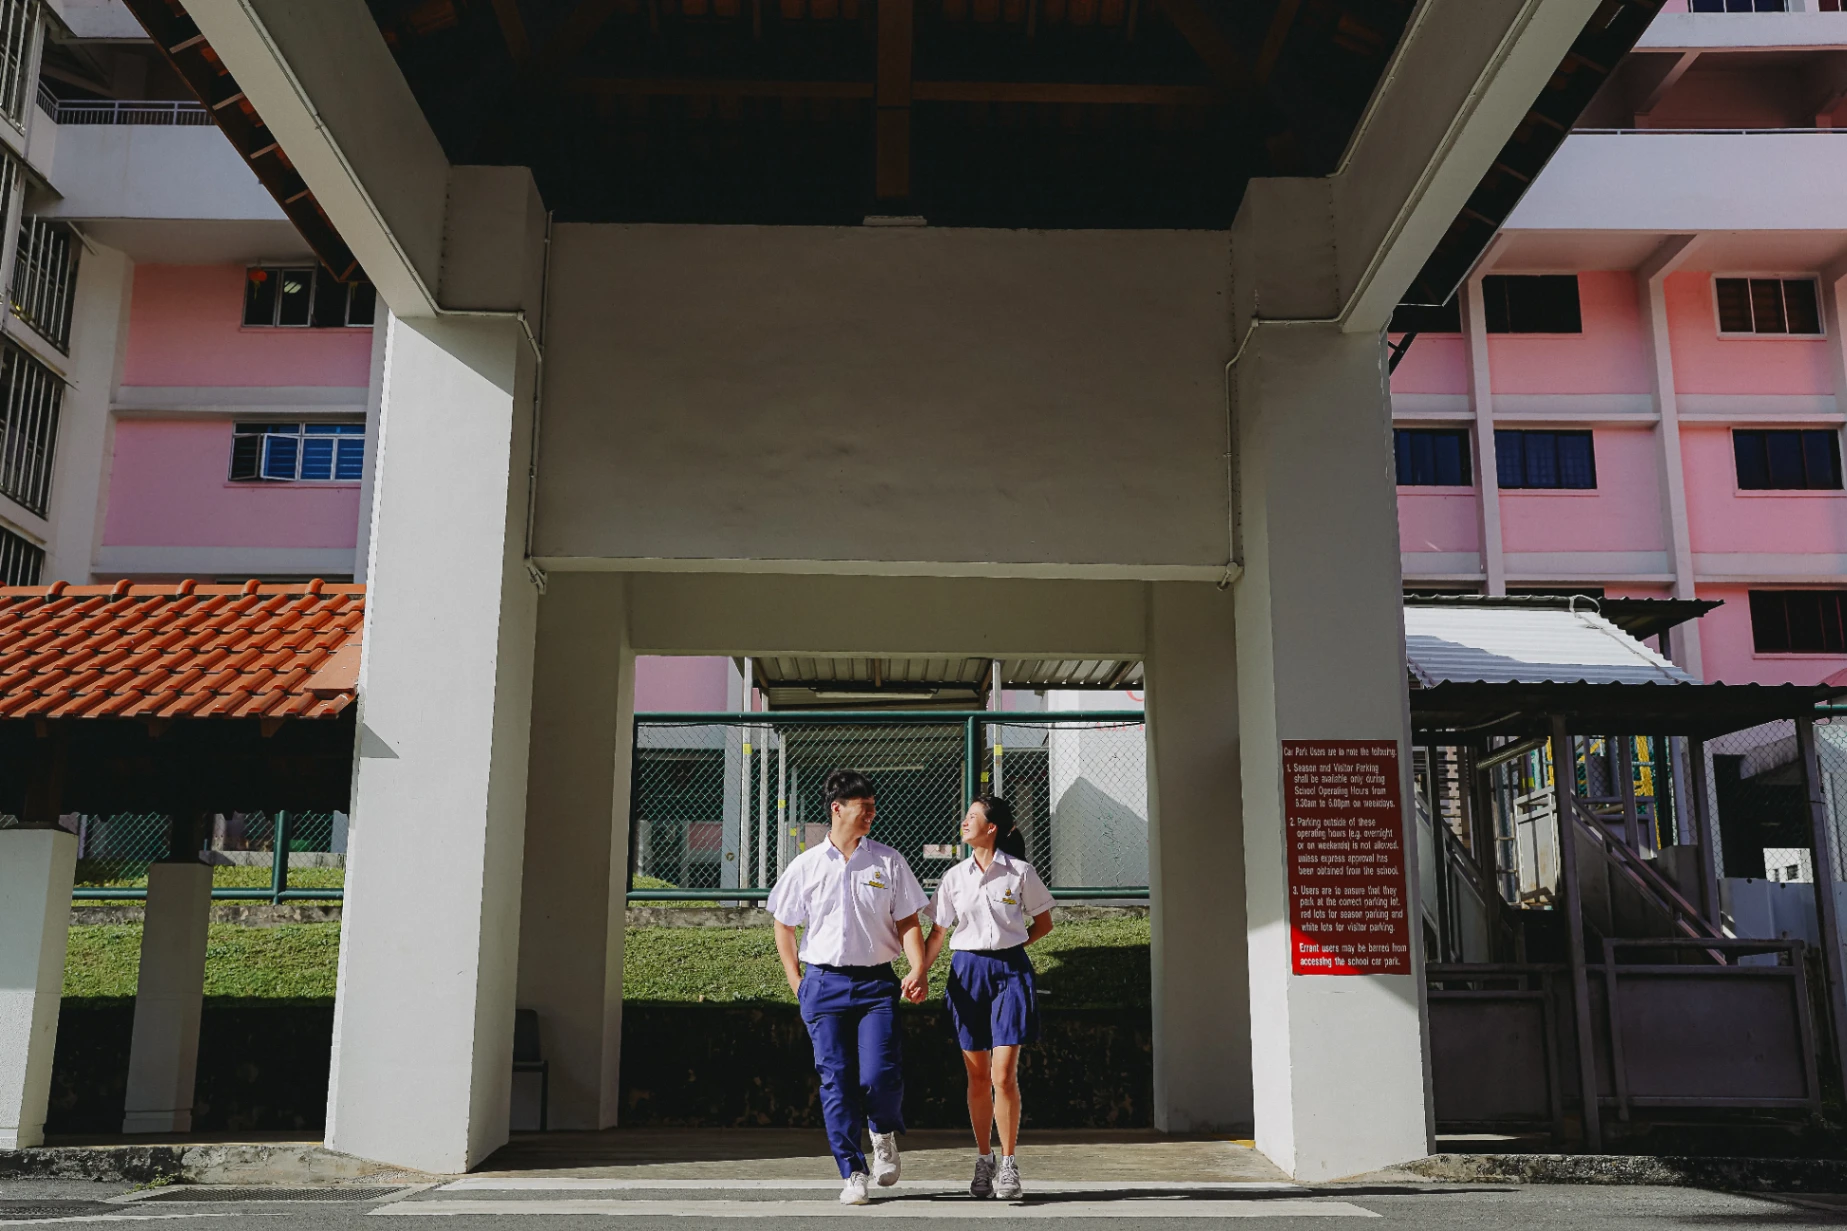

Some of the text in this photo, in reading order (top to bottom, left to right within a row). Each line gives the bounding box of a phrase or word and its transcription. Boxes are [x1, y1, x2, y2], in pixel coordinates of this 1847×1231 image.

[1284, 747, 1293, 756] Car
[1295, 747, 1307, 756] Park
[1309, 747, 1325, 756] Users
[1328, 748, 1336, 756] are
[1338, 747, 1345, 756] to
[1346, 748, 1358, 756] note
[1360, 747, 1369, 756] the
[1294, 763, 1317, 772] Season
[1319, 764, 1331, 772] and
[1334, 763, 1353, 772] Visitor
[1356, 763, 1379, 773] Parking
[1294, 774, 1385, 785] shall be available only during
[1294, 786, 1386, 797] School Operating Hours from
[1319, 799, 1326, 807] to
[1363, 799, 1395, 809] weekdays.
[1289, 818, 1376, 828] 2. Parking outside of these
[1296, 828, 1393, 839] operating hours (e.g. overnight
[1318, 841, 1350, 850] weekends)
[1352, 841, 1358, 850] is
[1360, 841, 1371, 850] not
[1298, 854, 1388, 864] unless express approval has
[1298, 866, 1399, 875] been obtained from the school.
[1293, 886, 1397, 896] 3. Users are to ensure that they
[1300, 898, 1314, 908] park
[1339, 898, 1362, 906] correct
[1364, 898, 1388, 908] parking
[1300, 910, 1403, 920] red lots for season parking and
[1301, 922, 1395, 933] white lots for visitor parking.
[1299, 943, 1407, 954] Errant users may be barred from
[1300, 957, 1332, 968] accessing
[1334, 957, 1345, 965] the
[1348, 957, 1368, 965] school
[1384, 957, 1400, 968] park.
